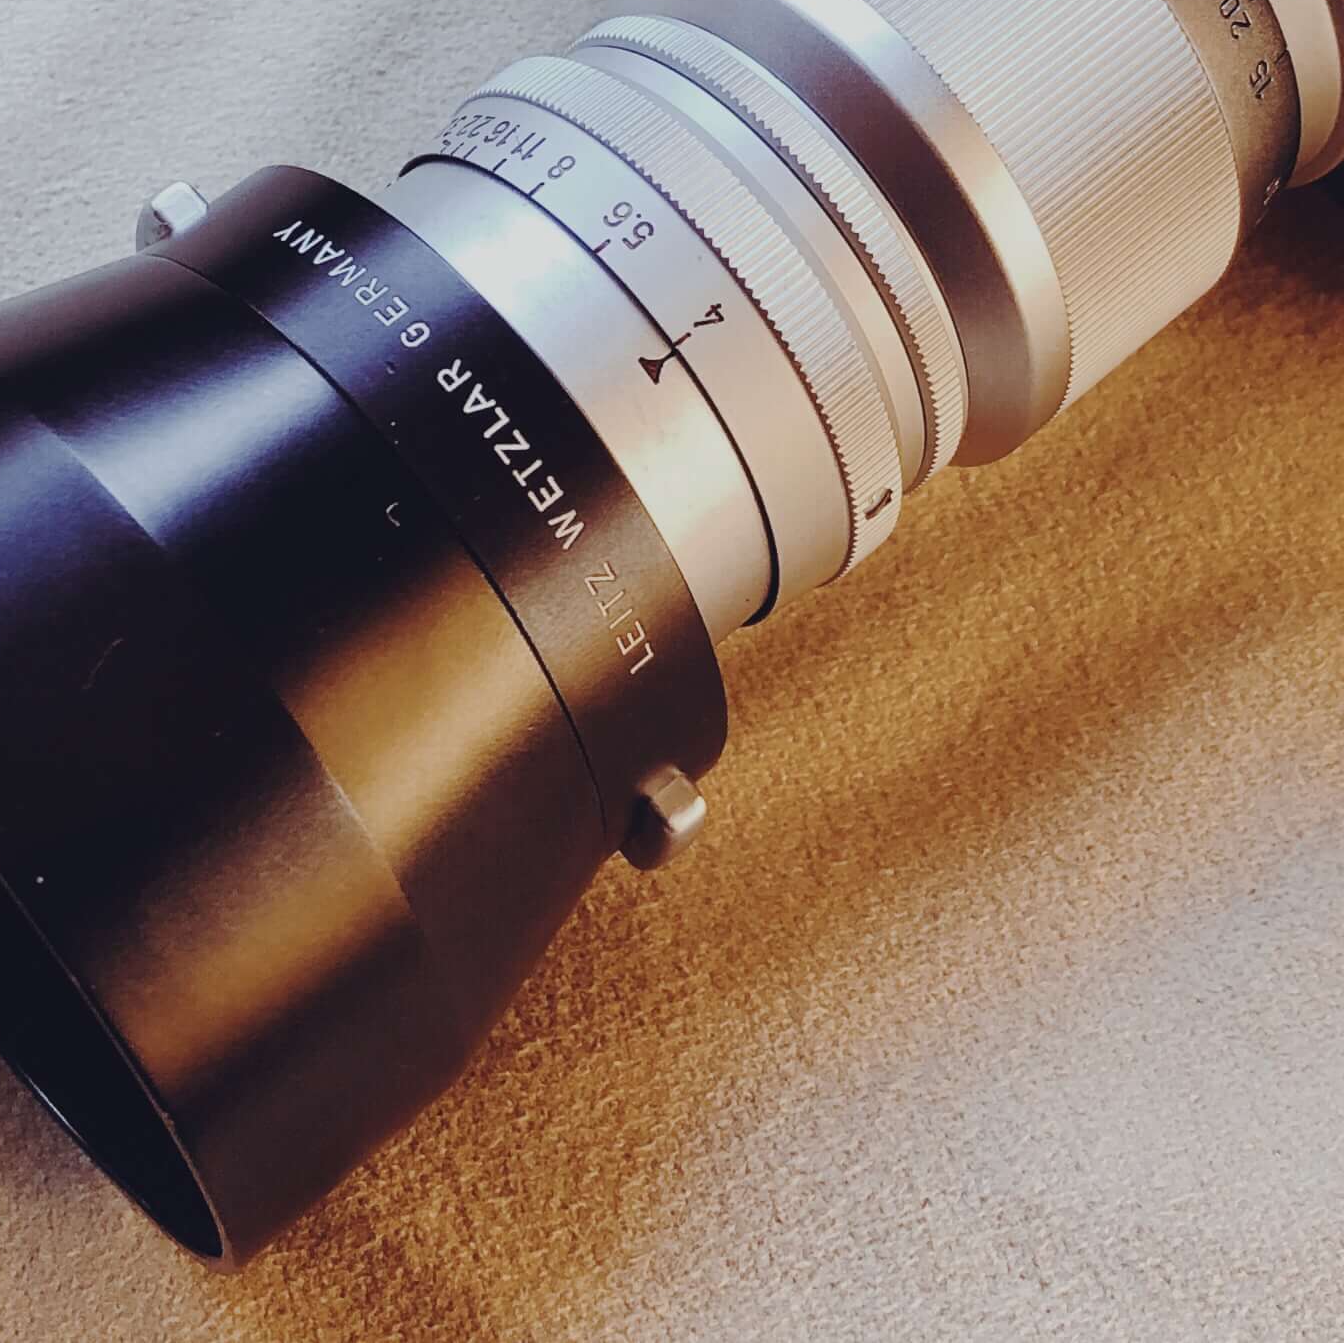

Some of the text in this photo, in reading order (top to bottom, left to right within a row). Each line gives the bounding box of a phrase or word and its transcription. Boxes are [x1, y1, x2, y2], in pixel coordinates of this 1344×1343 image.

[1249, 59, 1274, 100] 15
[484, 120, 521, 147] 16
[511, 132, 547, 160] 11
[547, 155, 576, 180] 8
[603, 201, 655, 250] 5.6
[693, 303, 725, 328] 4
[272, 220, 654, 675] LEITZ WETZLAR GERMANY
